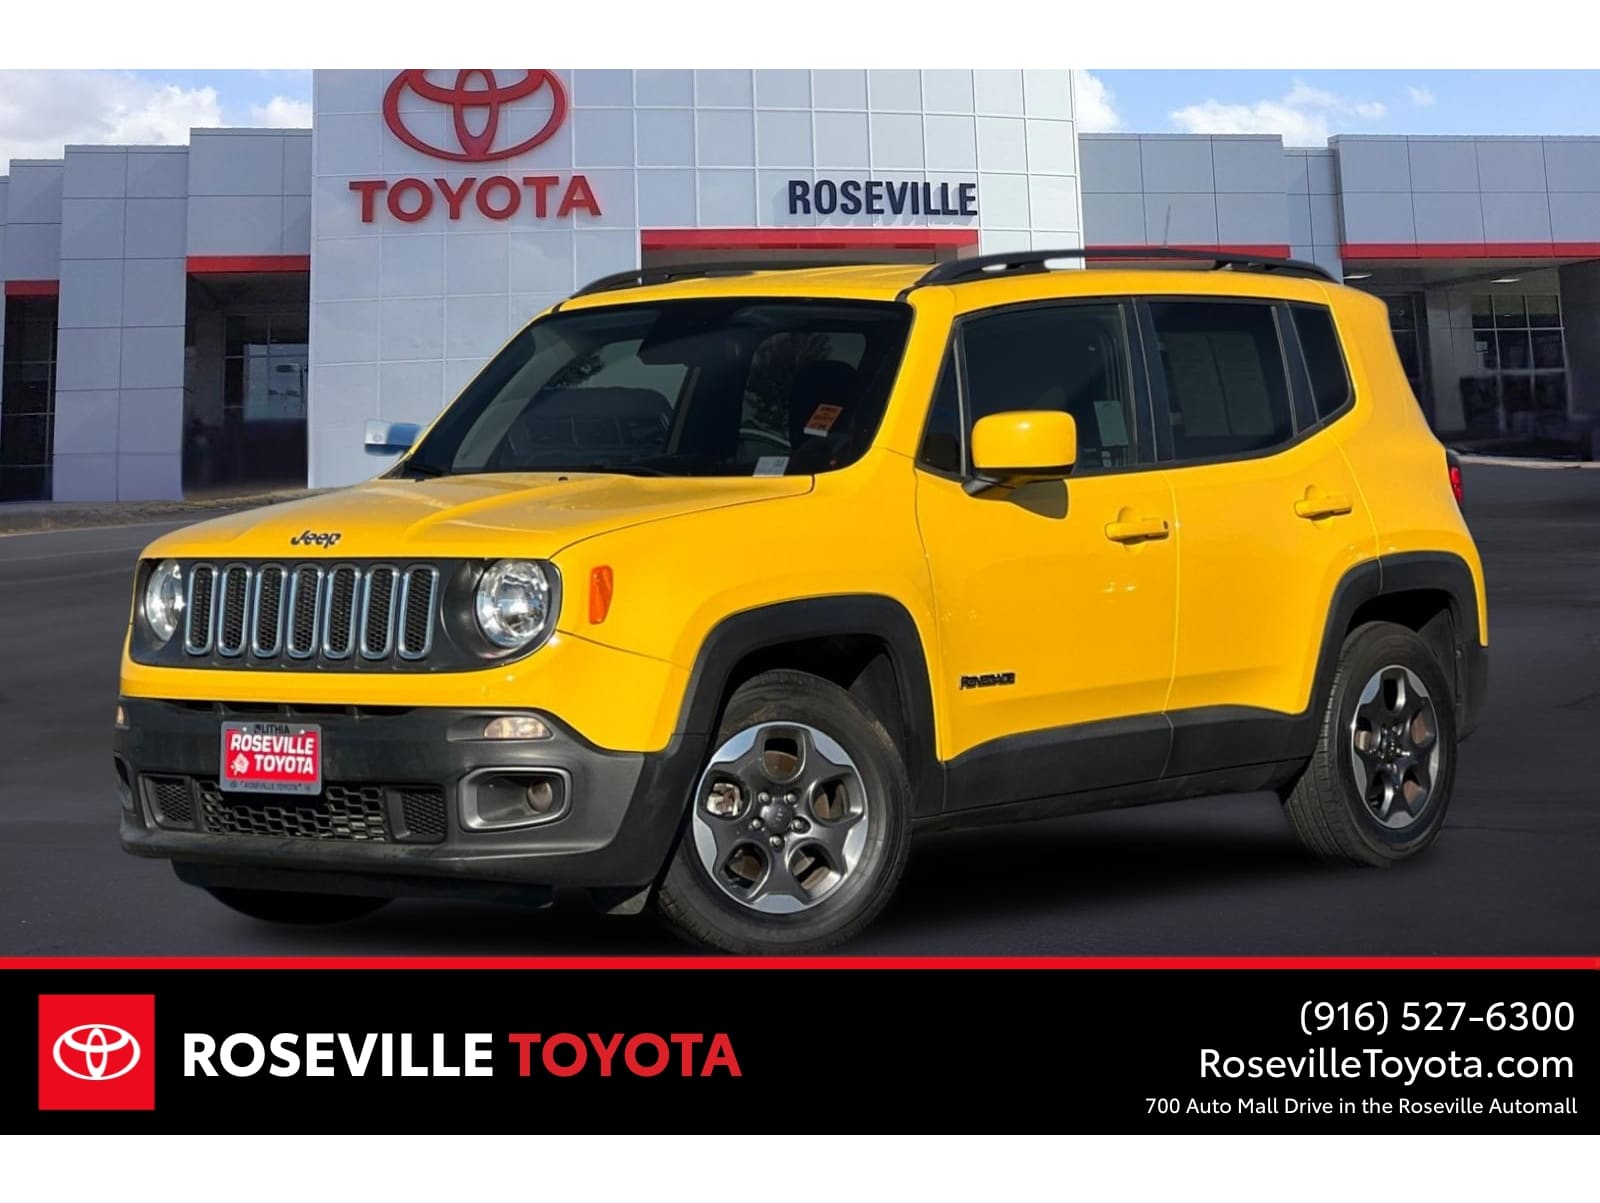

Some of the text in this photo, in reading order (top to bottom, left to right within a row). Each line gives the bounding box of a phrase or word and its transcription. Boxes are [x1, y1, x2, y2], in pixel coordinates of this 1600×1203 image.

[349, 175, 602, 223] TOYOTA
[788, 179, 978, 216] ROSEVILLE
[290, 529, 342, 549] Jeep
[230, 733, 315, 756] ROSEVILLE
[254, 754, 314, 775] TOYOTA
